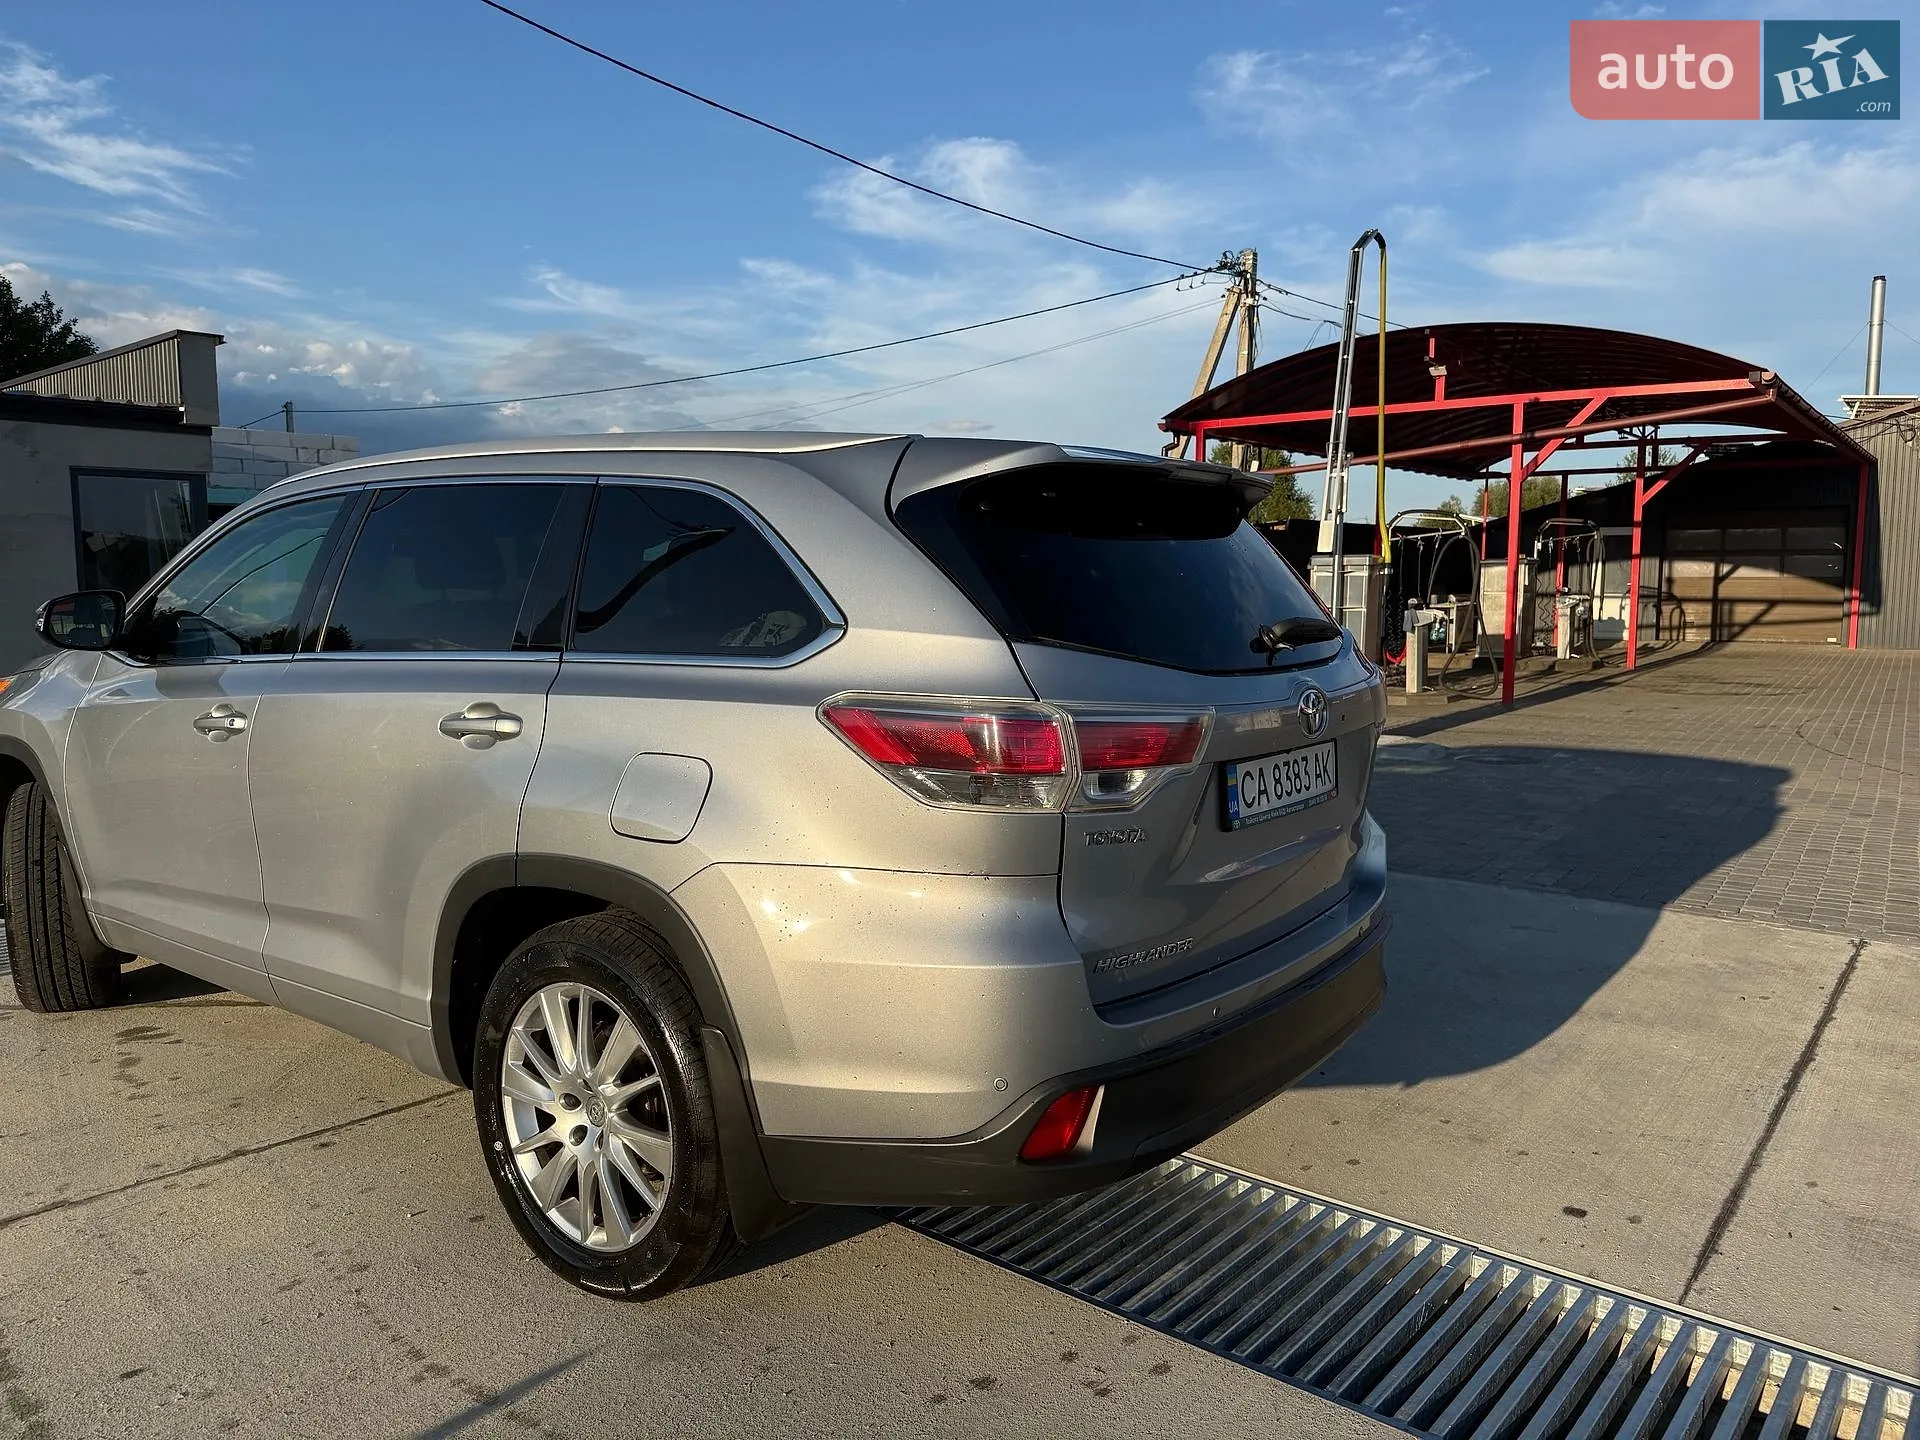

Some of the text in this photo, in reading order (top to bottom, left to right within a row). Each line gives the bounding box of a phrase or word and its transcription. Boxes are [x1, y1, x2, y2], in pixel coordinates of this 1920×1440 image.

[1241, 767, 1271, 809] CA
[1272, 755, 1311, 801] 8383
[1314, 749, 1332, 789] AK
[1228, 800, 1239, 813] UA
[1083, 827, 1147, 846] TOYOTA
[1092, 936, 1194, 974] HIGHLANDER
